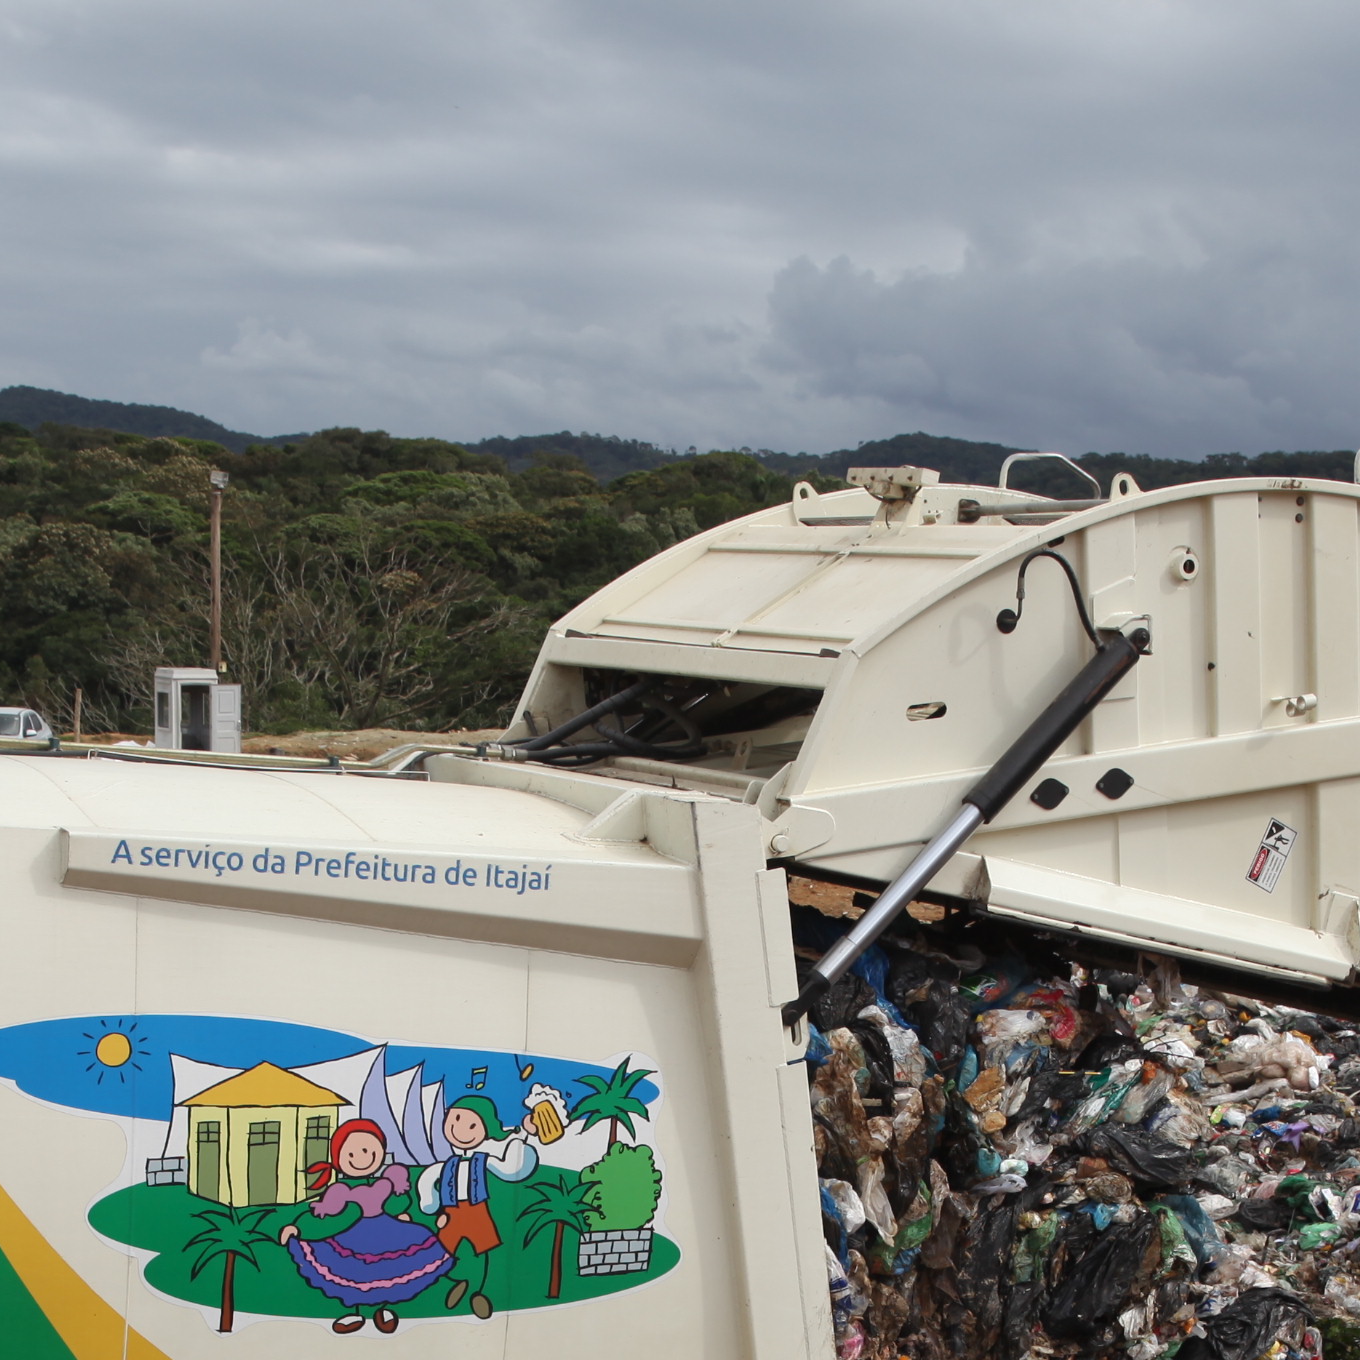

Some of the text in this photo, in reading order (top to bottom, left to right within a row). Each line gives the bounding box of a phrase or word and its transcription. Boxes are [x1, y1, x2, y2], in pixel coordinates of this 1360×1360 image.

[111, 839, 553, 896] A serviço da Prefeitura de Itajaí
